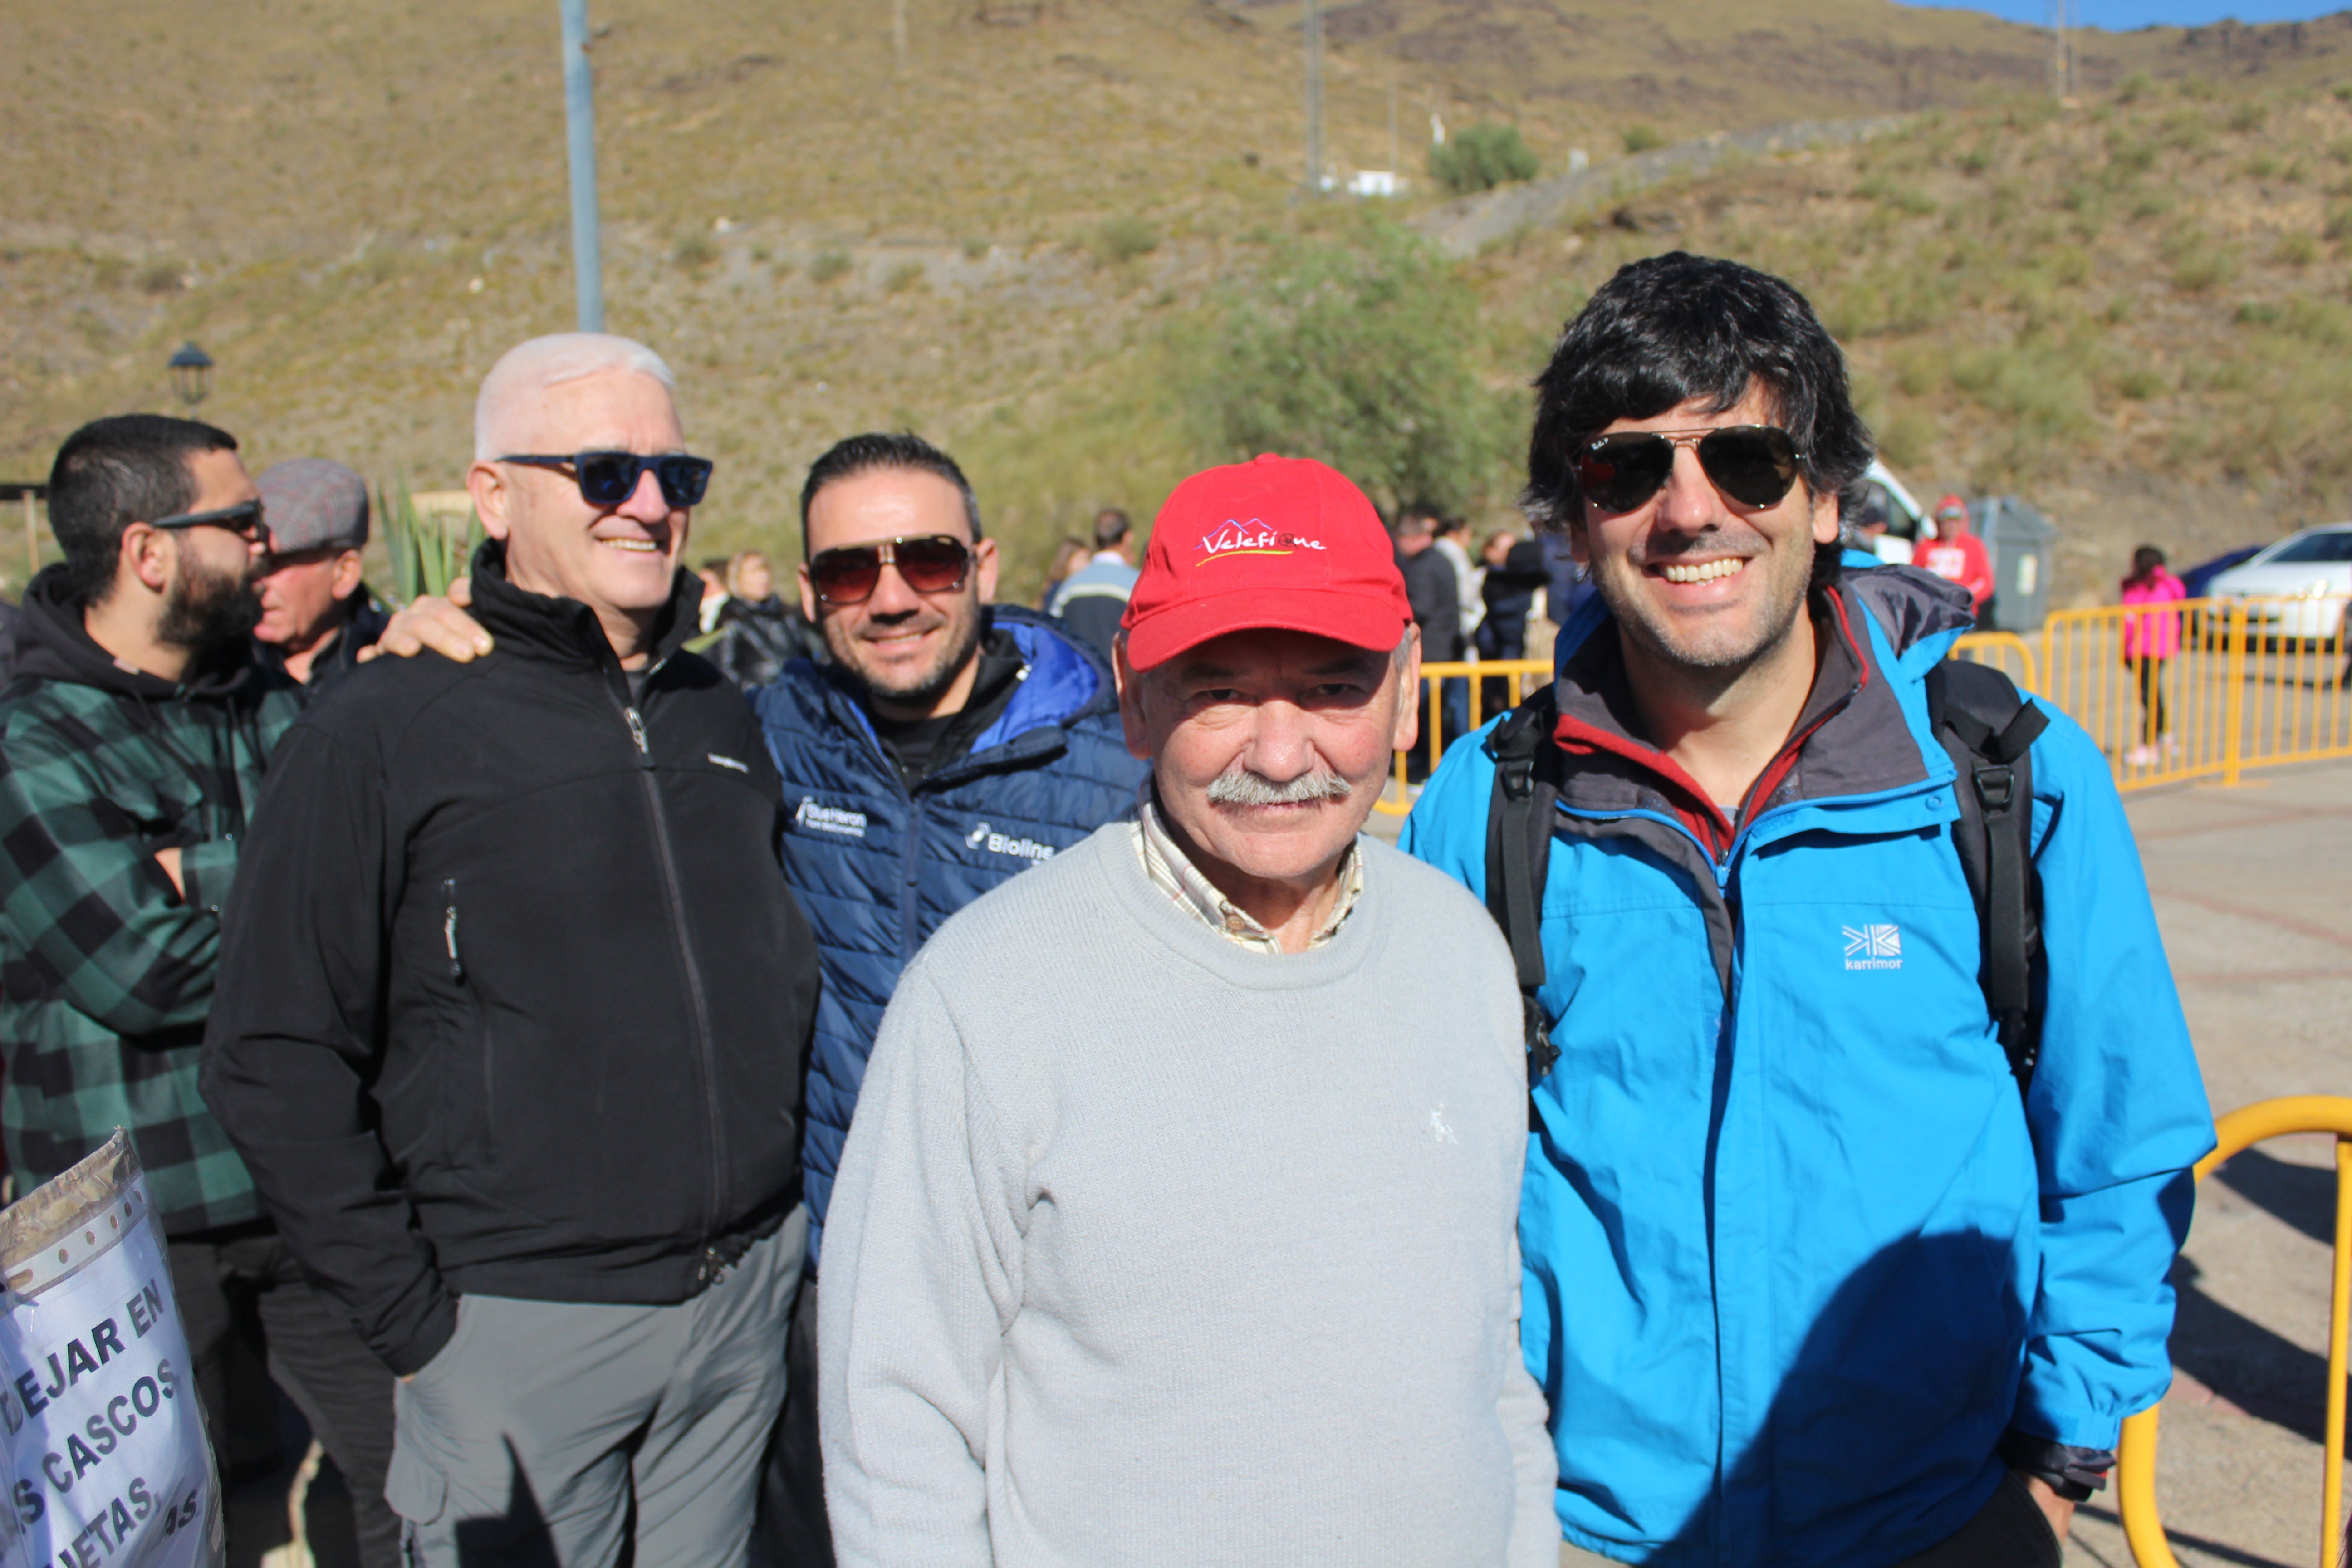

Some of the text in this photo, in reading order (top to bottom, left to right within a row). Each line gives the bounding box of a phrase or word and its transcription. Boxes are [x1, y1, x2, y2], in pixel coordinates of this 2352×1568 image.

[988, 833, 1055, 860] Bioline
[1845, 957, 1903, 970] karrimor
[127, 1279, 164, 1338] EN
[43, 1359, 176, 1493] CASCOS
